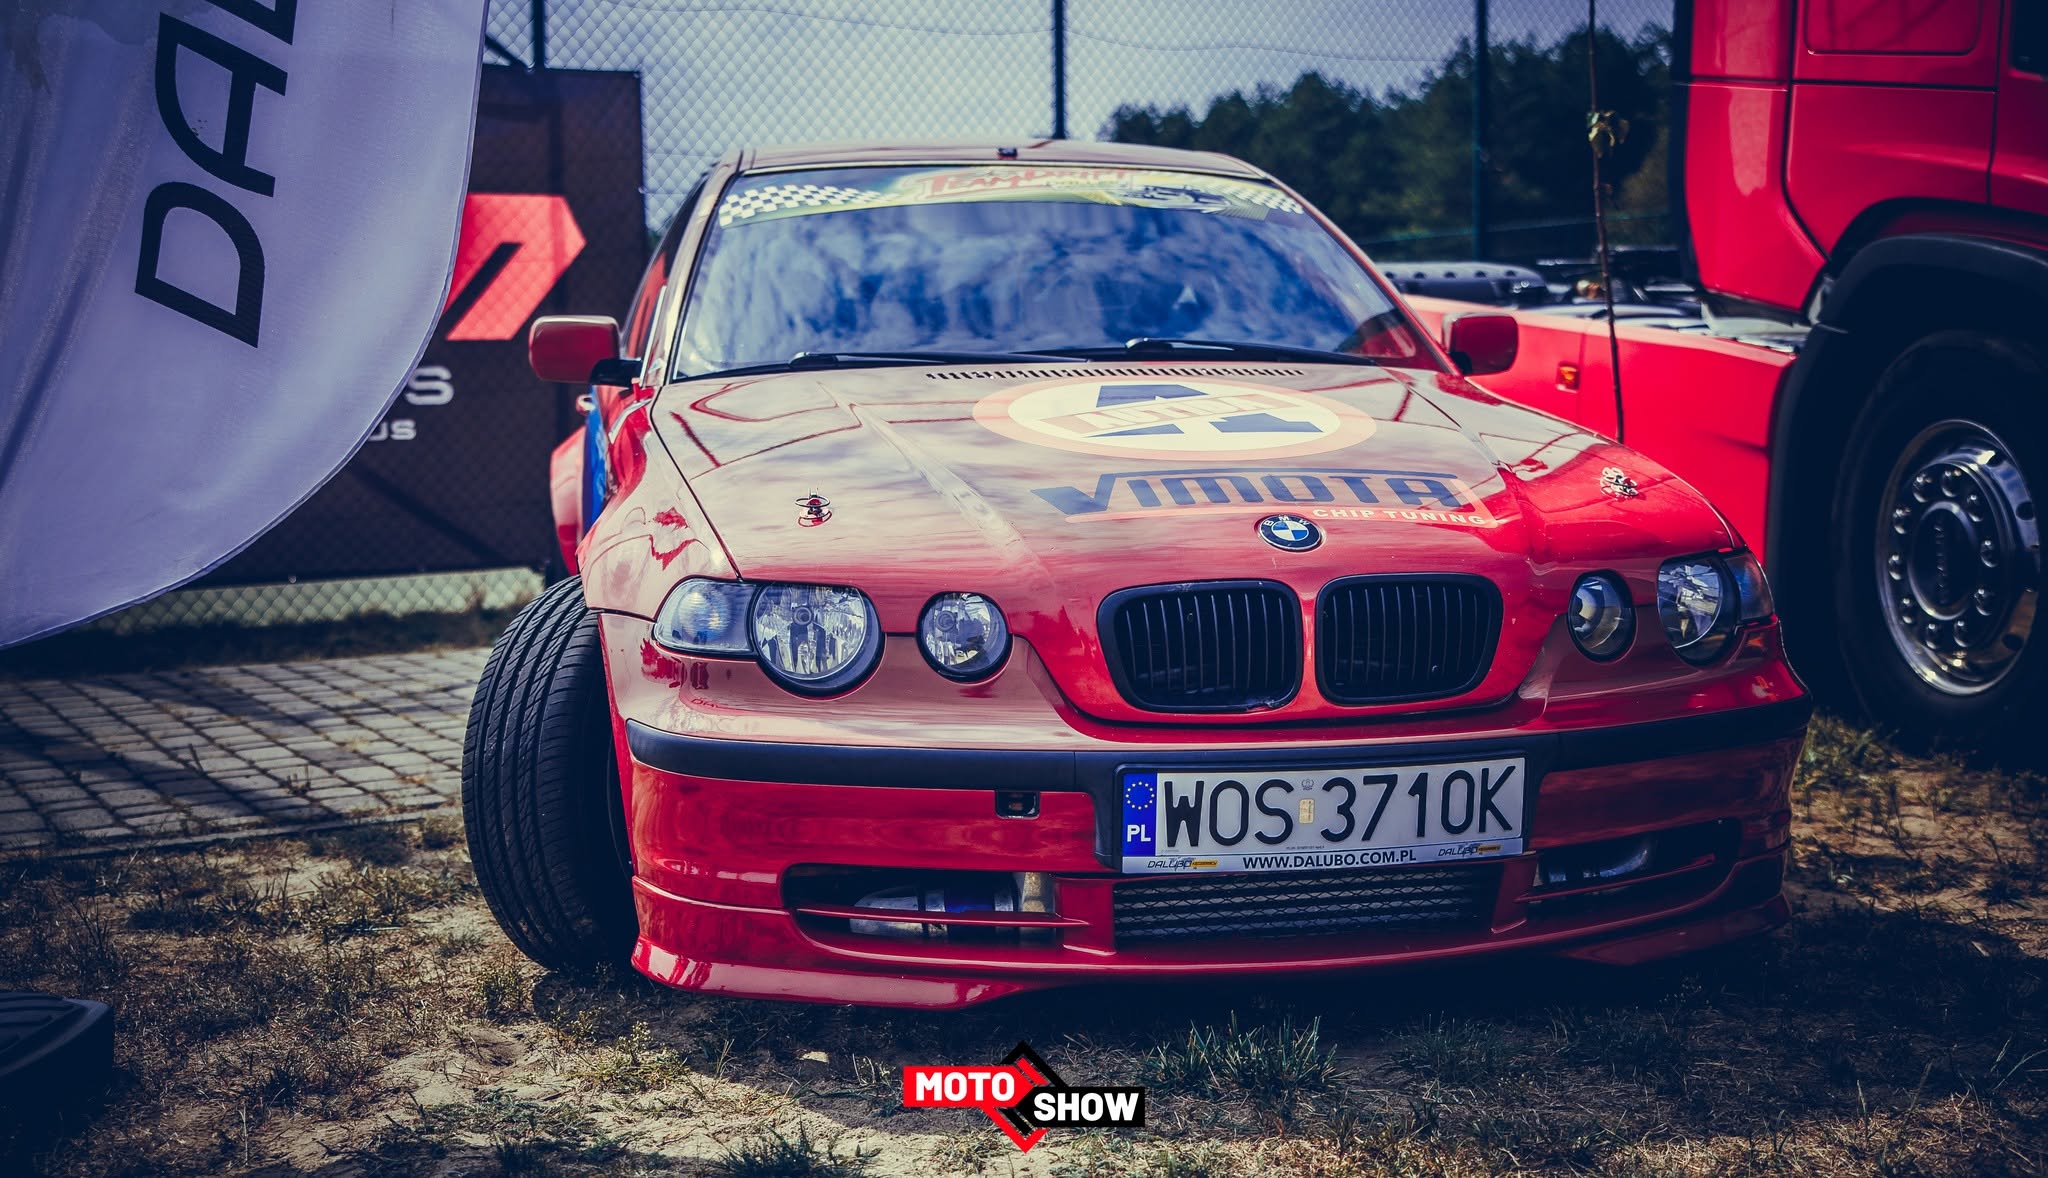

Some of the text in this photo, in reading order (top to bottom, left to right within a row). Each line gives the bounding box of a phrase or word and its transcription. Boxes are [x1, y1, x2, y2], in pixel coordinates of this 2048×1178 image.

[1031, 466, 1462, 515] VIMOTA
[1312, 508, 1488, 526] CHIP TUNING
[1164, 765, 1516, 848] WOS 3710K
[1126, 824, 1151, 843] PL
[1243, 850, 1417, 869] WWW.DALUBO.COM.PL
